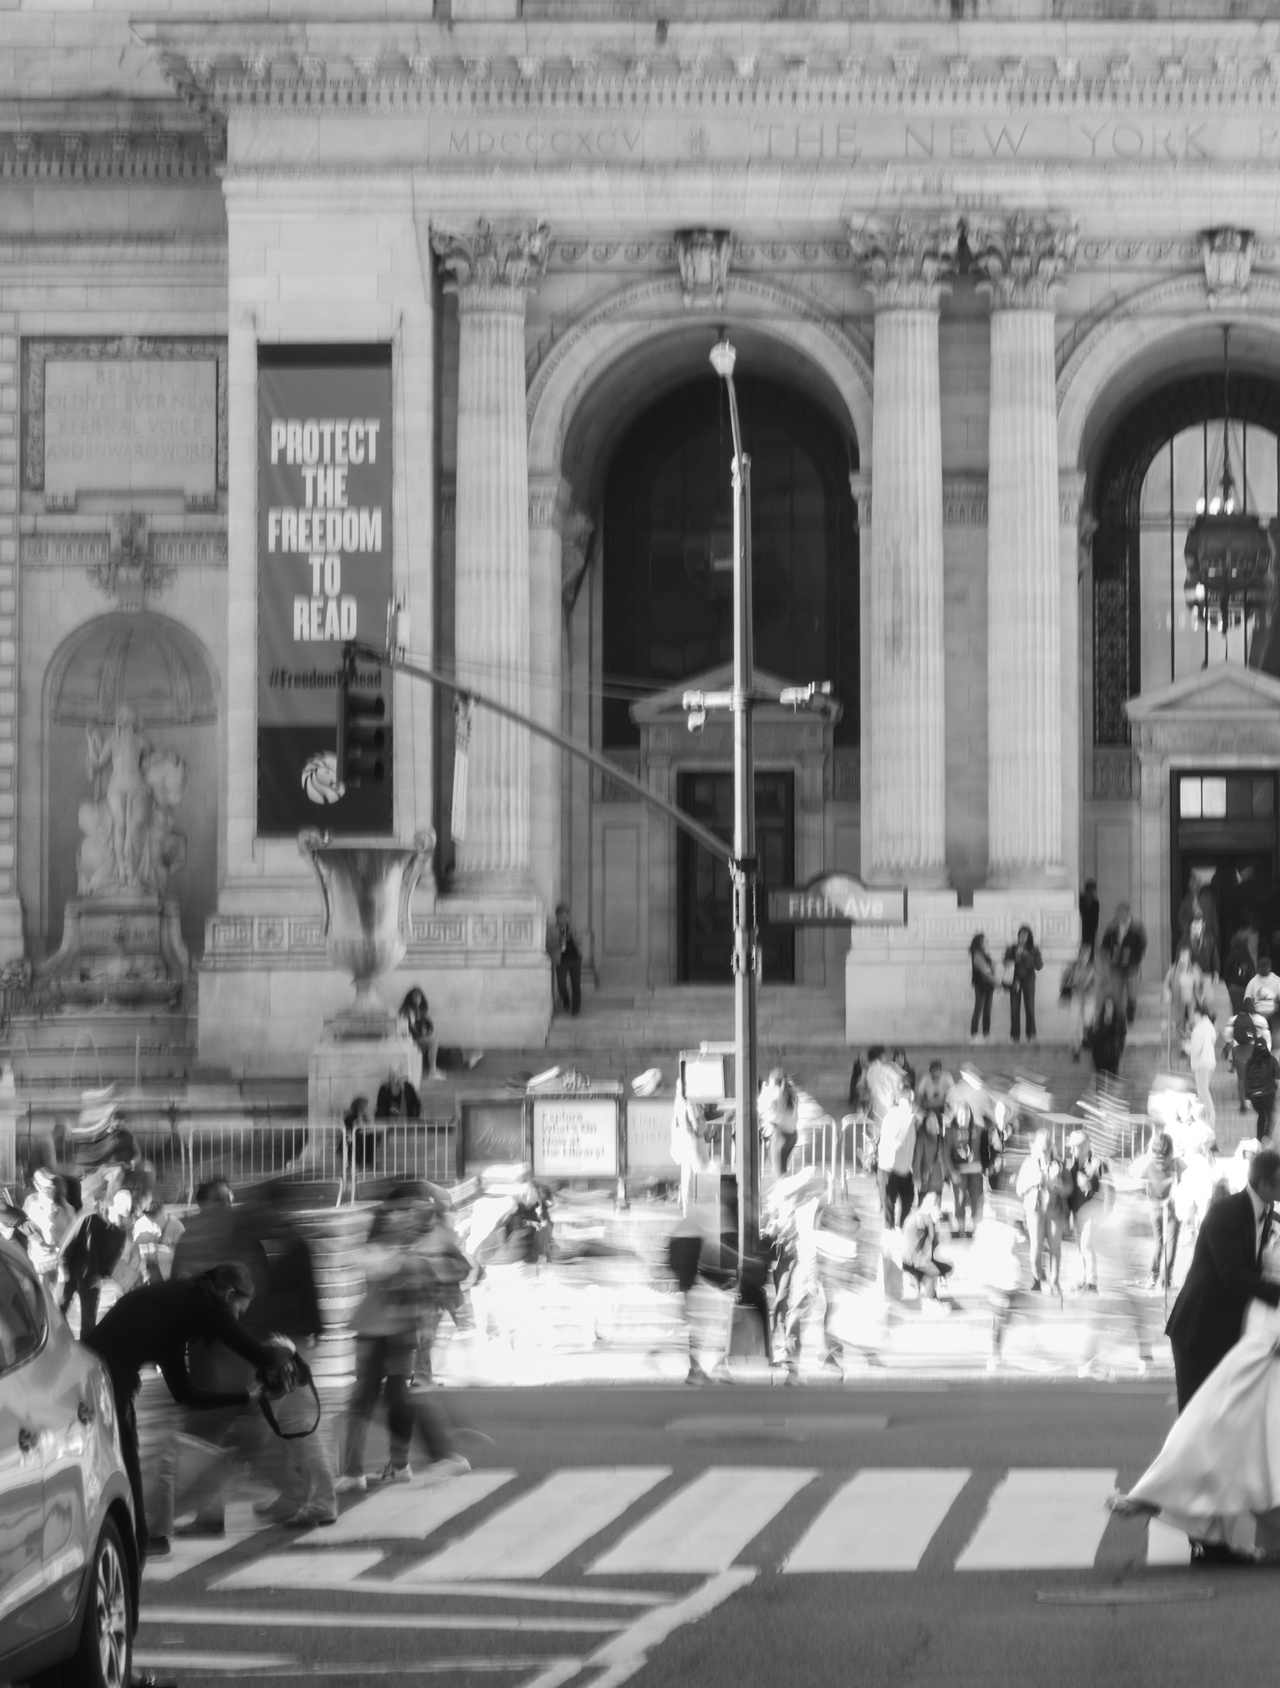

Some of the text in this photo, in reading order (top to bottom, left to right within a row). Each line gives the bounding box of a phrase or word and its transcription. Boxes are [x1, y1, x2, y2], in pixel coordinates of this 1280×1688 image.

[448, 127, 643, 156] MDCCCXCV
[753, 120, 862, 160] THE
[903, 121, 1028, 160] NEW
[1078, 121, 1214, 160] YORK
[96, 369, 168, 385] BEAUTY
[271, 418, 380, 464] PROTECT
[301, 463, 348, 508] THE
[268, 506, 382, 552] FREEDOM
[308, 552, 341, 596] TO
[293, 595, 357, 641] READ
[269, 668, 382, 690] #FreedomRead
[788, 893, 884, 919] Fifth Ave
